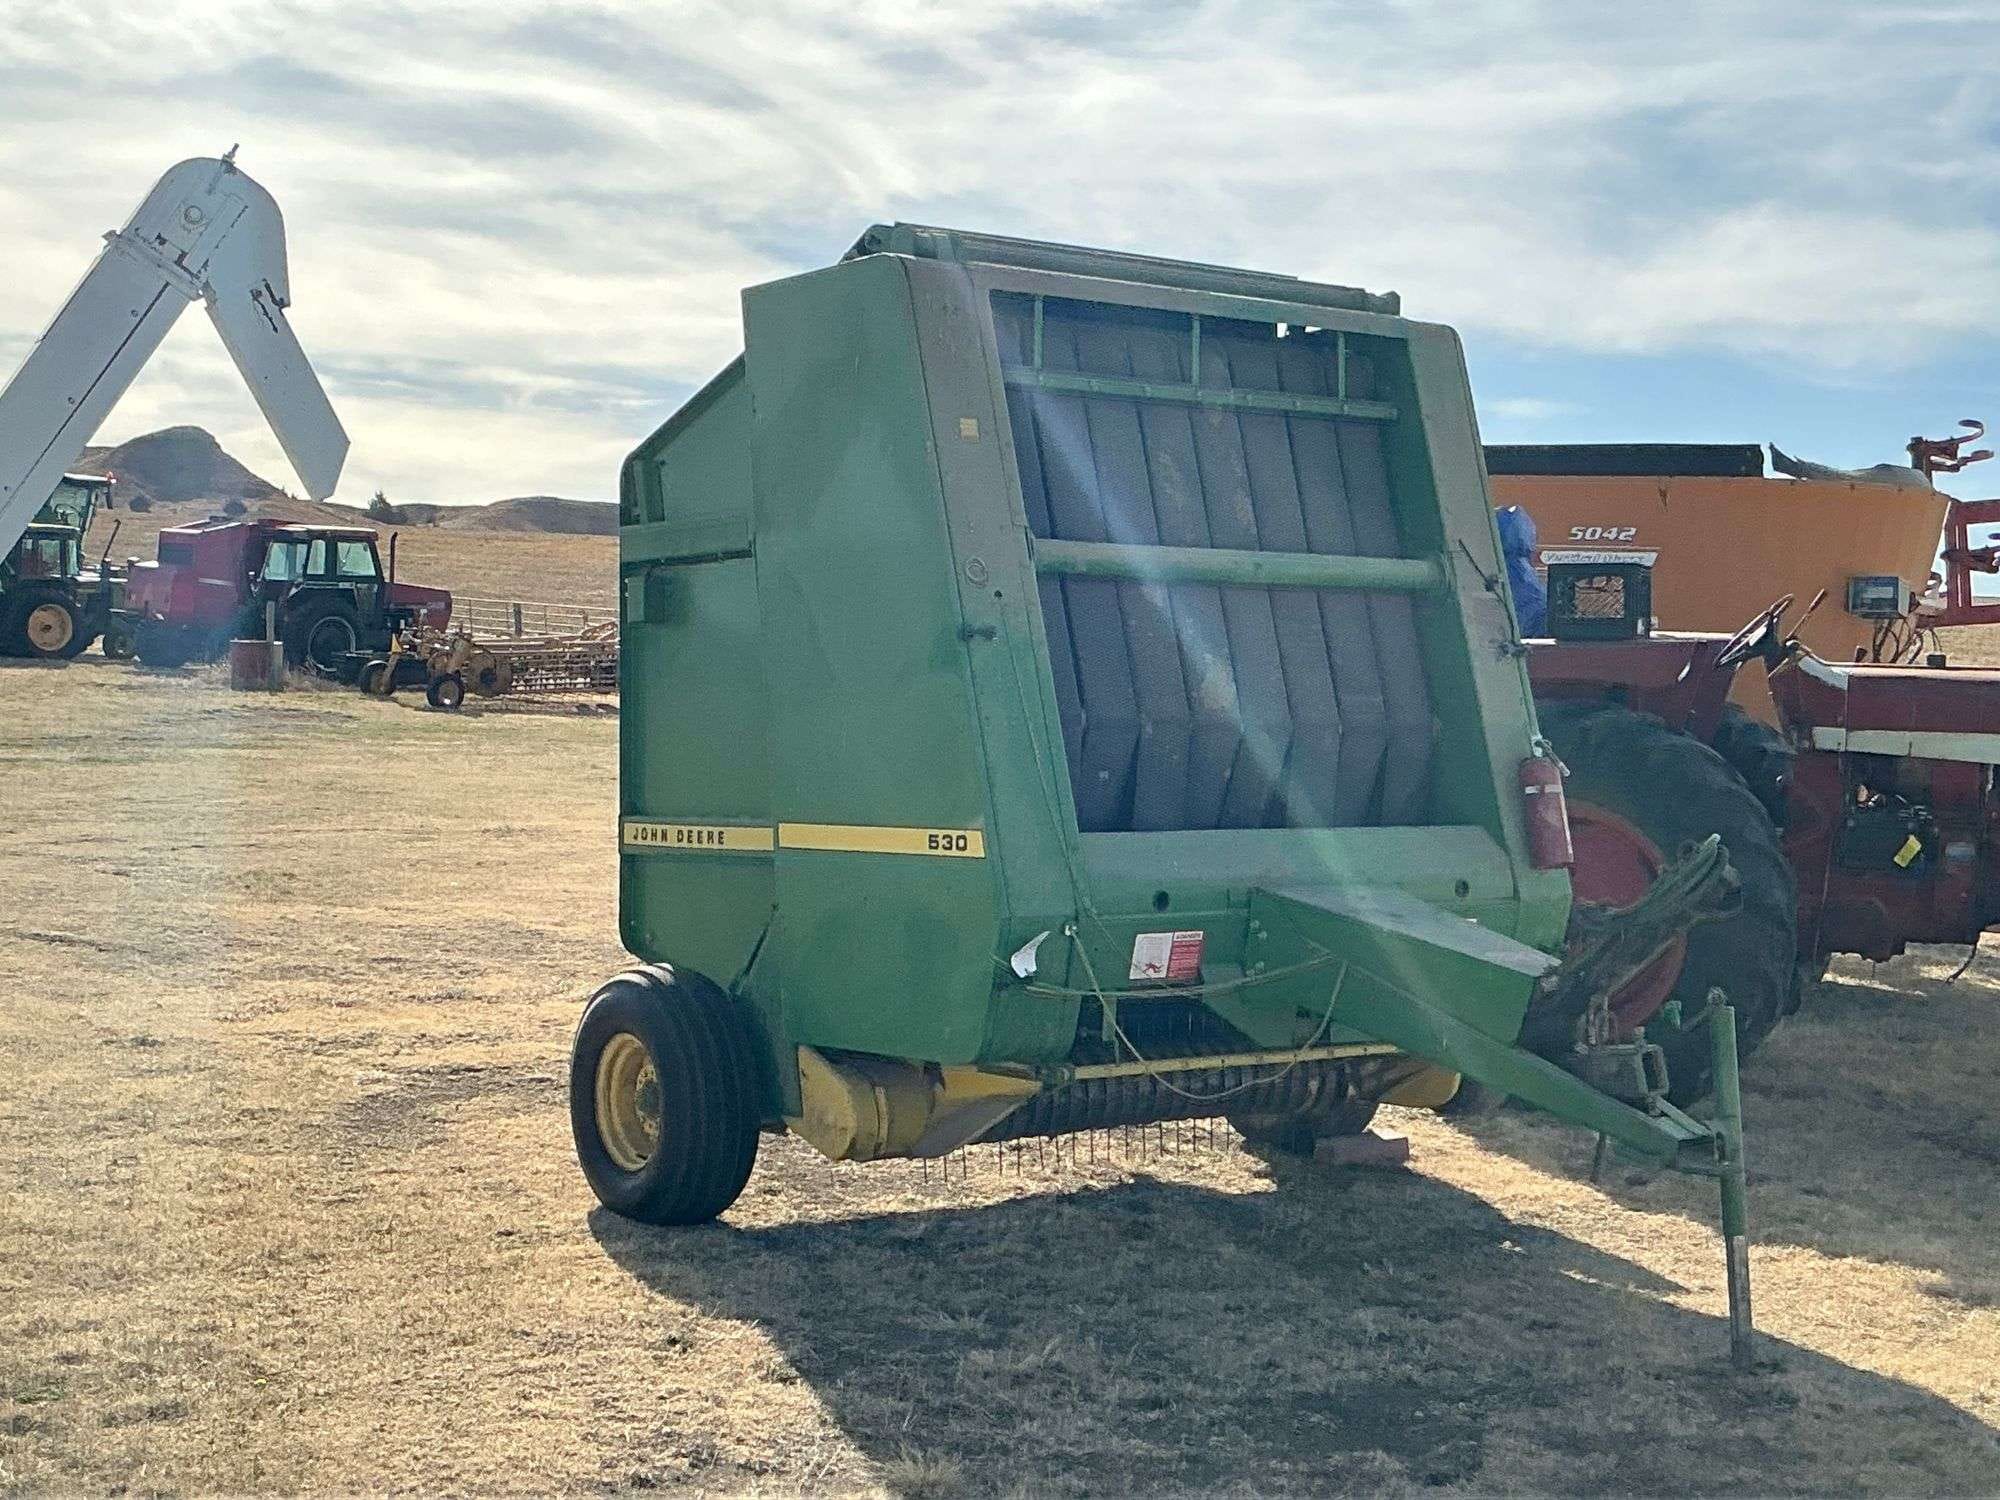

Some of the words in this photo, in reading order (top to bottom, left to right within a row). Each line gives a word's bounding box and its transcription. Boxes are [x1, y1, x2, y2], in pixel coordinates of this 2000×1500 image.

[1568, 526, 1637, 541] 5042
[633, 827, 668, 843] JOHN
[676, 829, 725, 845] DEERE
[928, 833, 968, 852] 530
